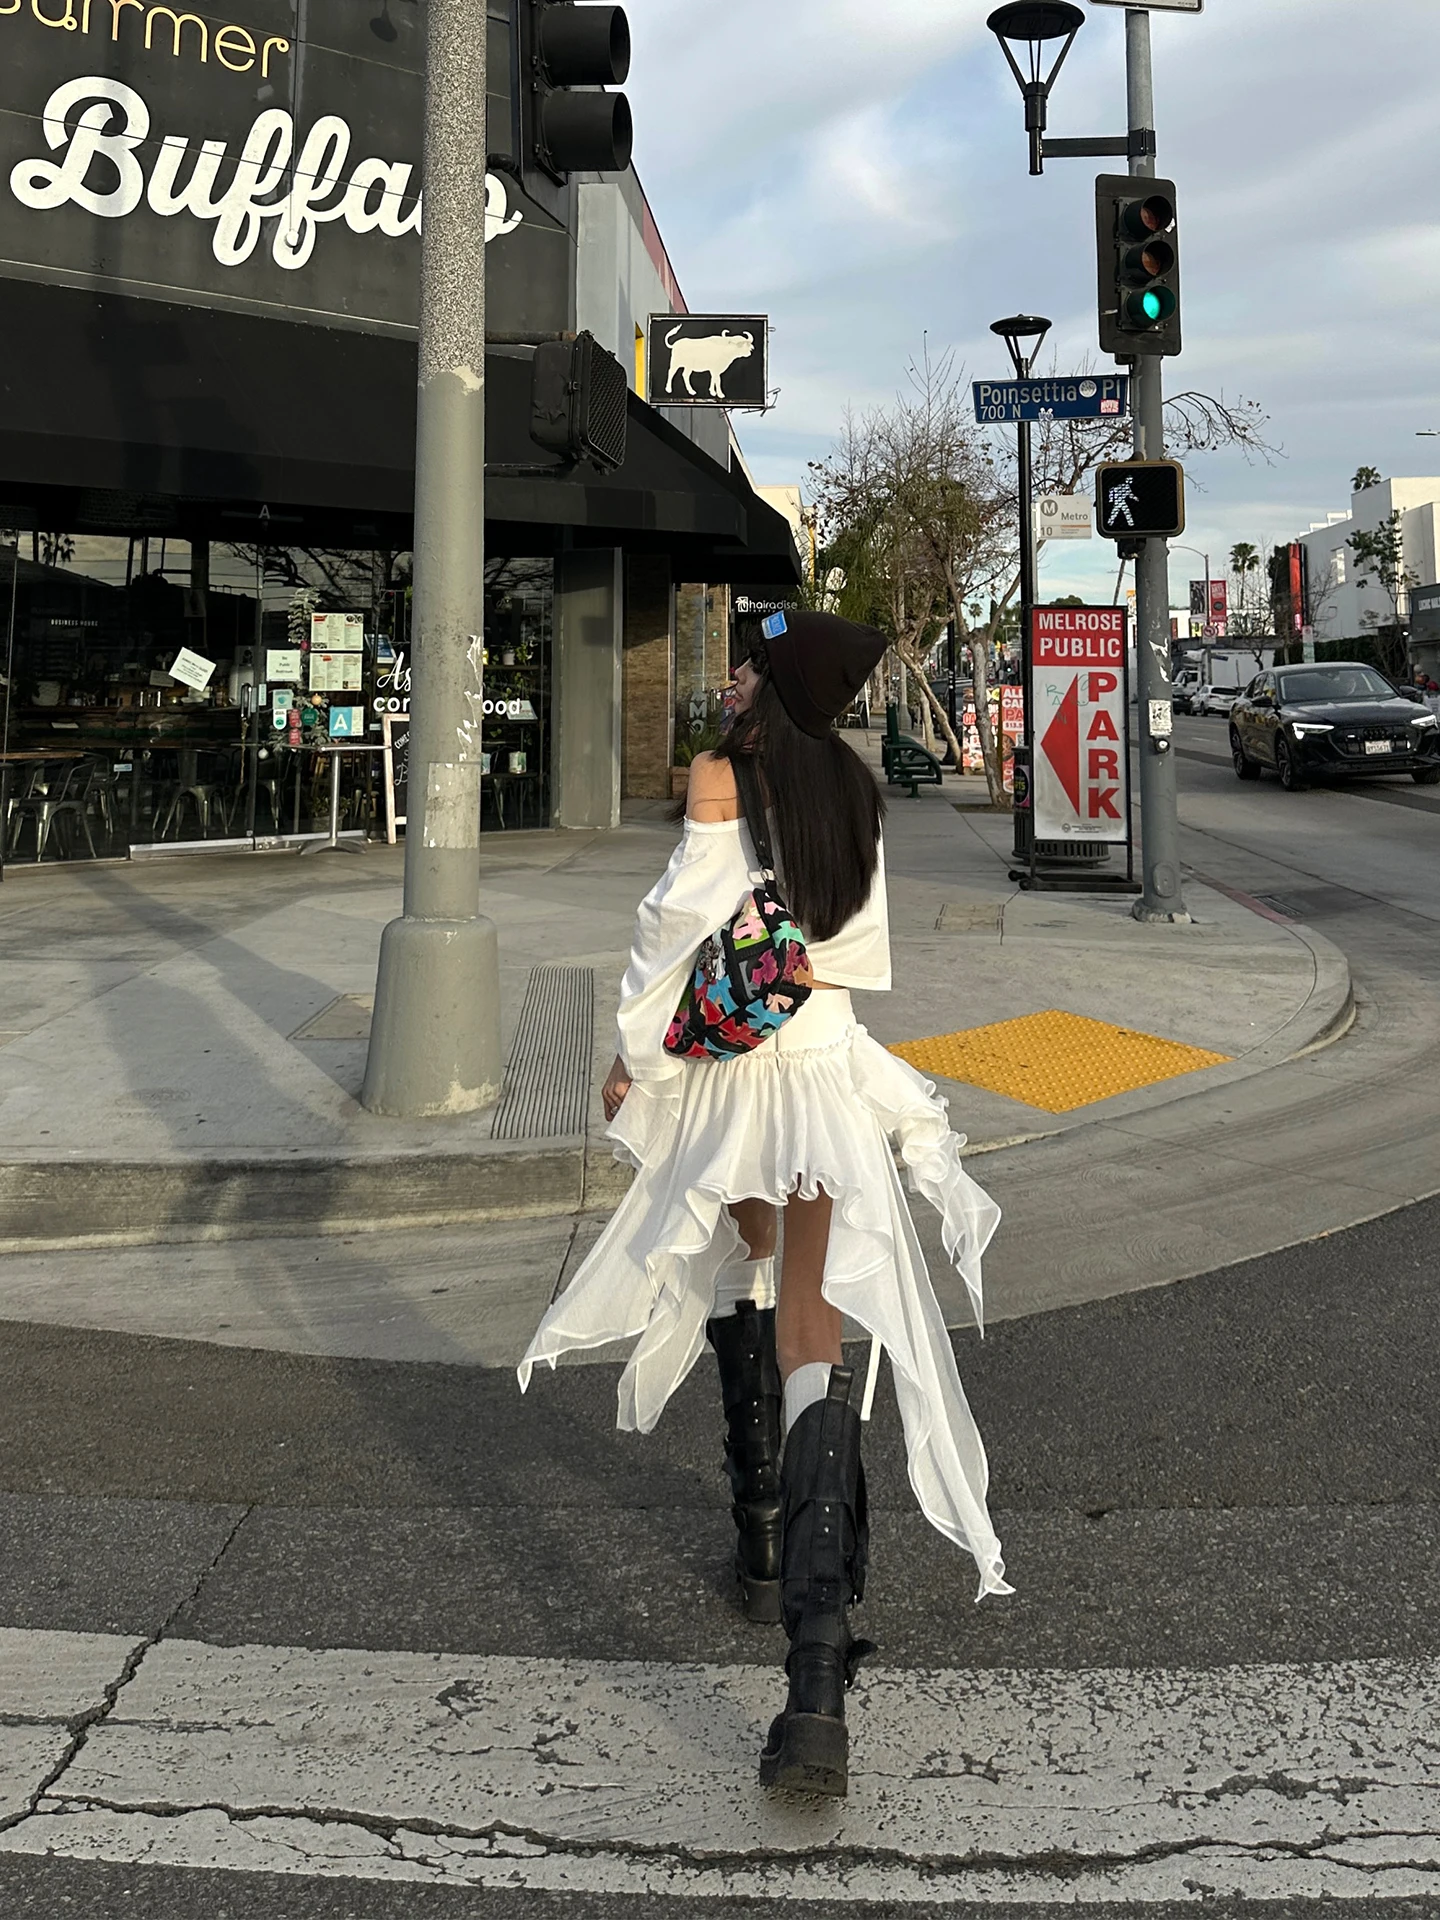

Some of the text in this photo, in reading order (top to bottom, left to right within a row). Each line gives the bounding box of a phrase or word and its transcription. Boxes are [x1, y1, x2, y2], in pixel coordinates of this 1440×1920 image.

[980, 383, 1077, 406] Poinsettia
[1102, 378, 1121, 400] Pl
[980, 404, 1022, 420] 700 N
[1061, 512, 1089, 521] Metro
[1041, 526, 1053, 537] 10
[749, 599, 798, 610] hairadise
[1038, 613, 1122, 631] MELROSE
[1039, 637, 1121, 658] PUBLIC
[333, 713, 348, 731] A
[1086, 671, 1123, 820] PARK
